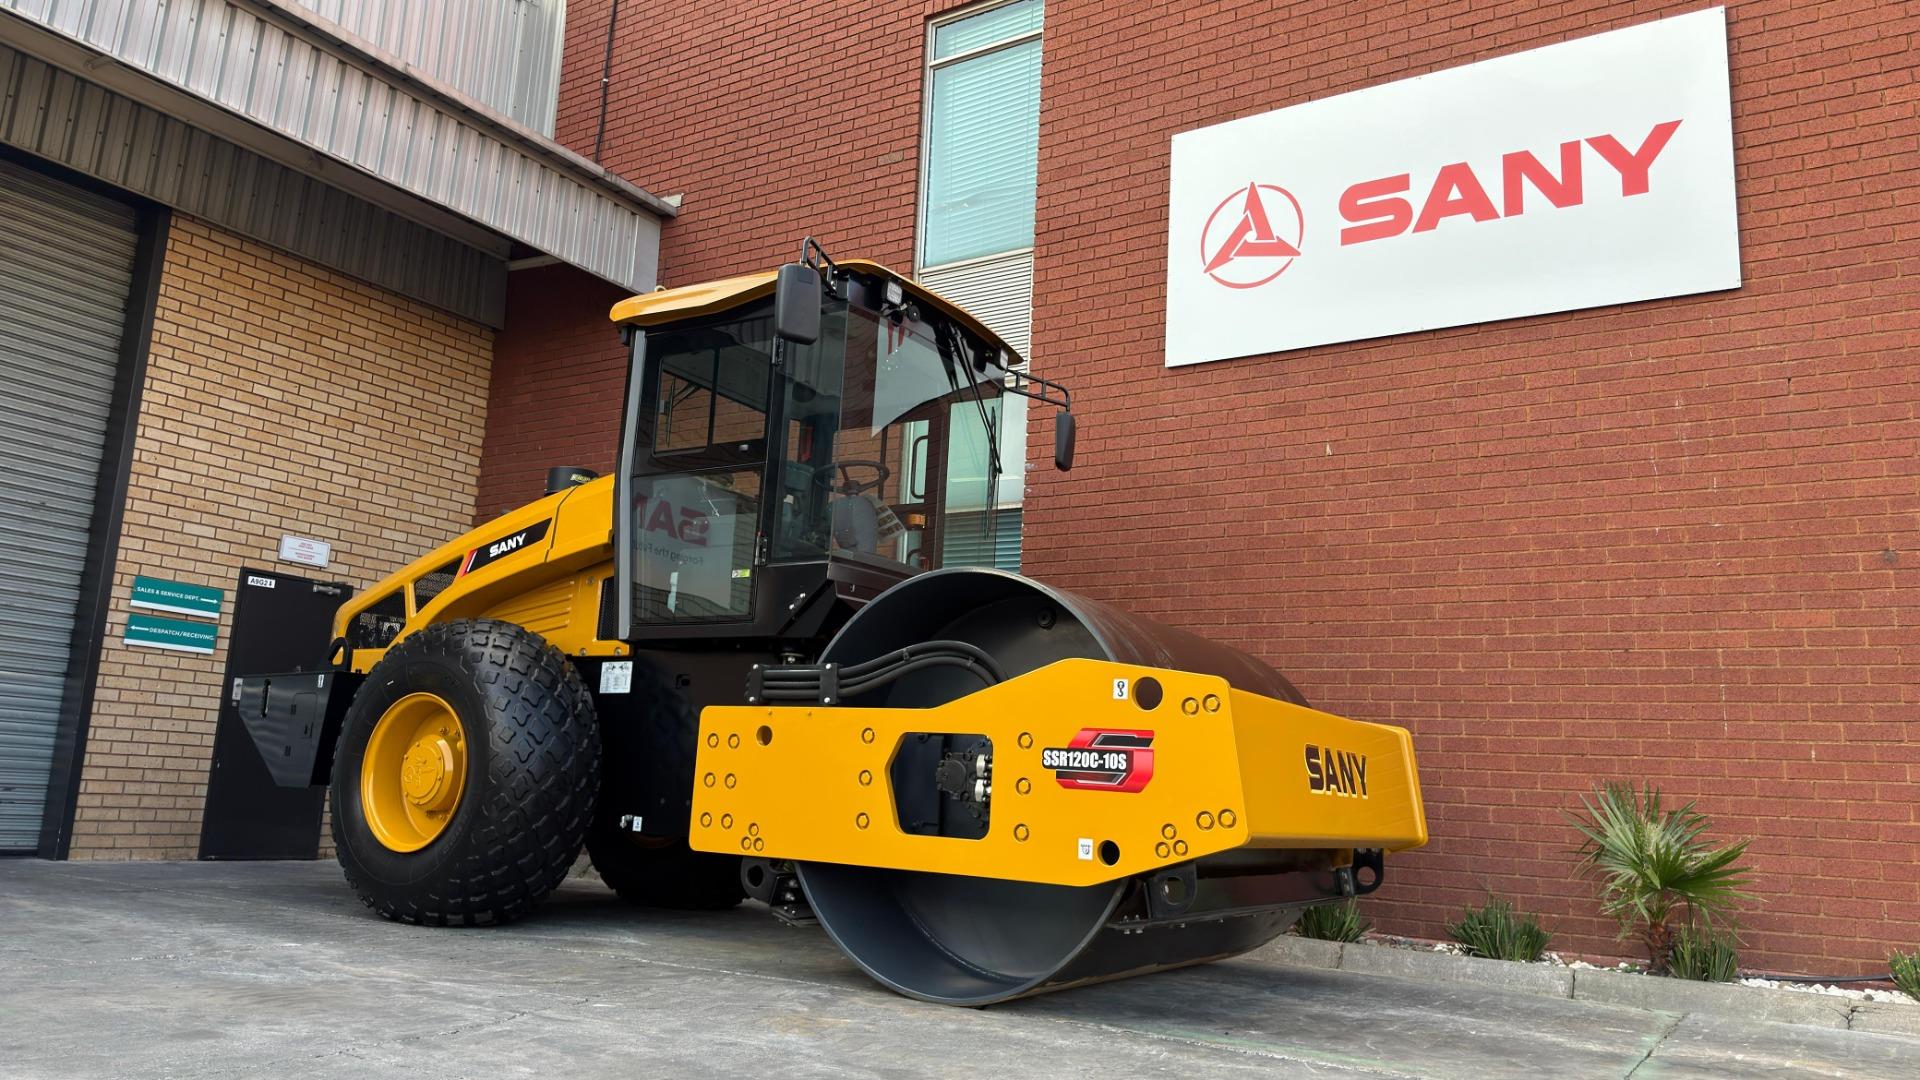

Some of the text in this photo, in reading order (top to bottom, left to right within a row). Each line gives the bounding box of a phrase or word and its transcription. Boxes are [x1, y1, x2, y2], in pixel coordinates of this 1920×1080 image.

[1339, 119, 1683, 246] SANY
[489, 533, 527, 558] SANY
[137, 586, 154, 594] SALES
[160, 590, 184, 599] SERVICE
[149, 627, 215, 640] DESPATCH/RECEIVING
[1043, 749, 1127, 770] SSR120C-10S
[1305, 743, 1368, 799] SANY
